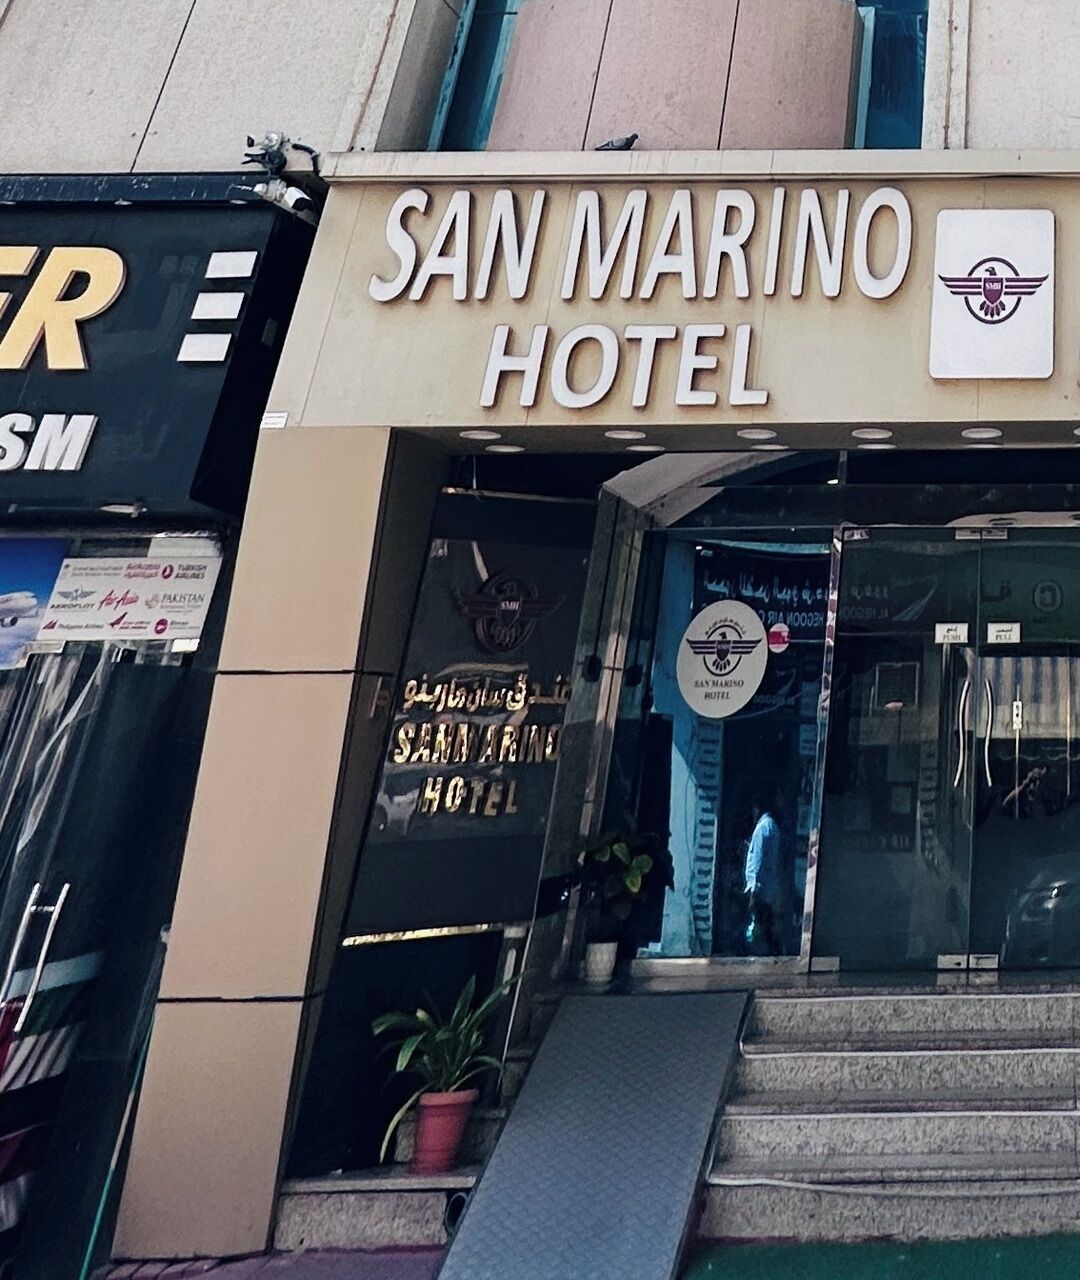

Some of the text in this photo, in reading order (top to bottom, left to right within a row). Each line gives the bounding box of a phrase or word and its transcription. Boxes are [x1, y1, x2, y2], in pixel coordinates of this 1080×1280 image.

[368, 186, 912, 302] SAN MARINO
[479, 324, 769, 408] HOTEL
[160, 593, 205, 604] PAKISTAN
[694, 680, 745, 688] SAN MARINO
[704, 691, 731, 700] HOTEL
[418, 775, 518, 817] HOTEL
